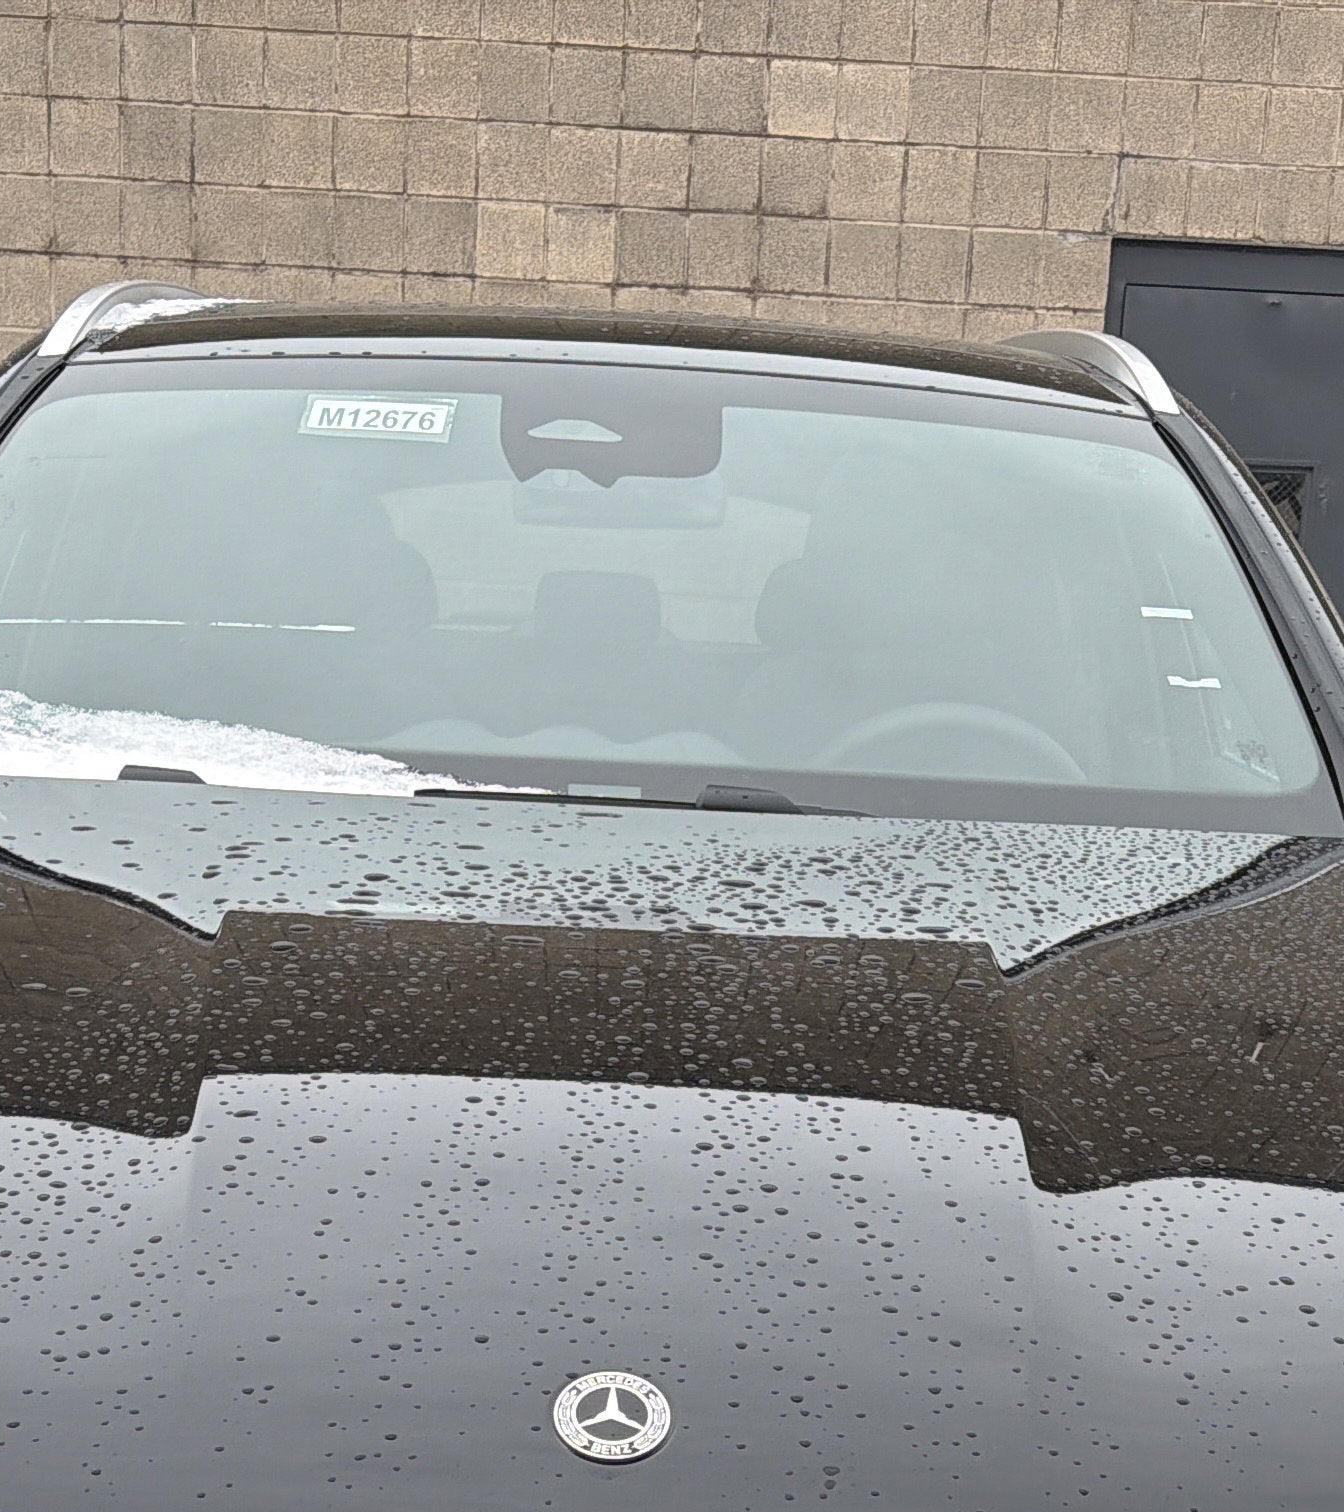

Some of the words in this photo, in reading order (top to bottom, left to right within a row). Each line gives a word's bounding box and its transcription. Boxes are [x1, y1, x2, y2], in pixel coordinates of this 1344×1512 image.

[317, 406, 436, 431] M12676
[576, 1374, 650, 1395] MERCEDES
[590, 1443, 633, 1456] BENZ
